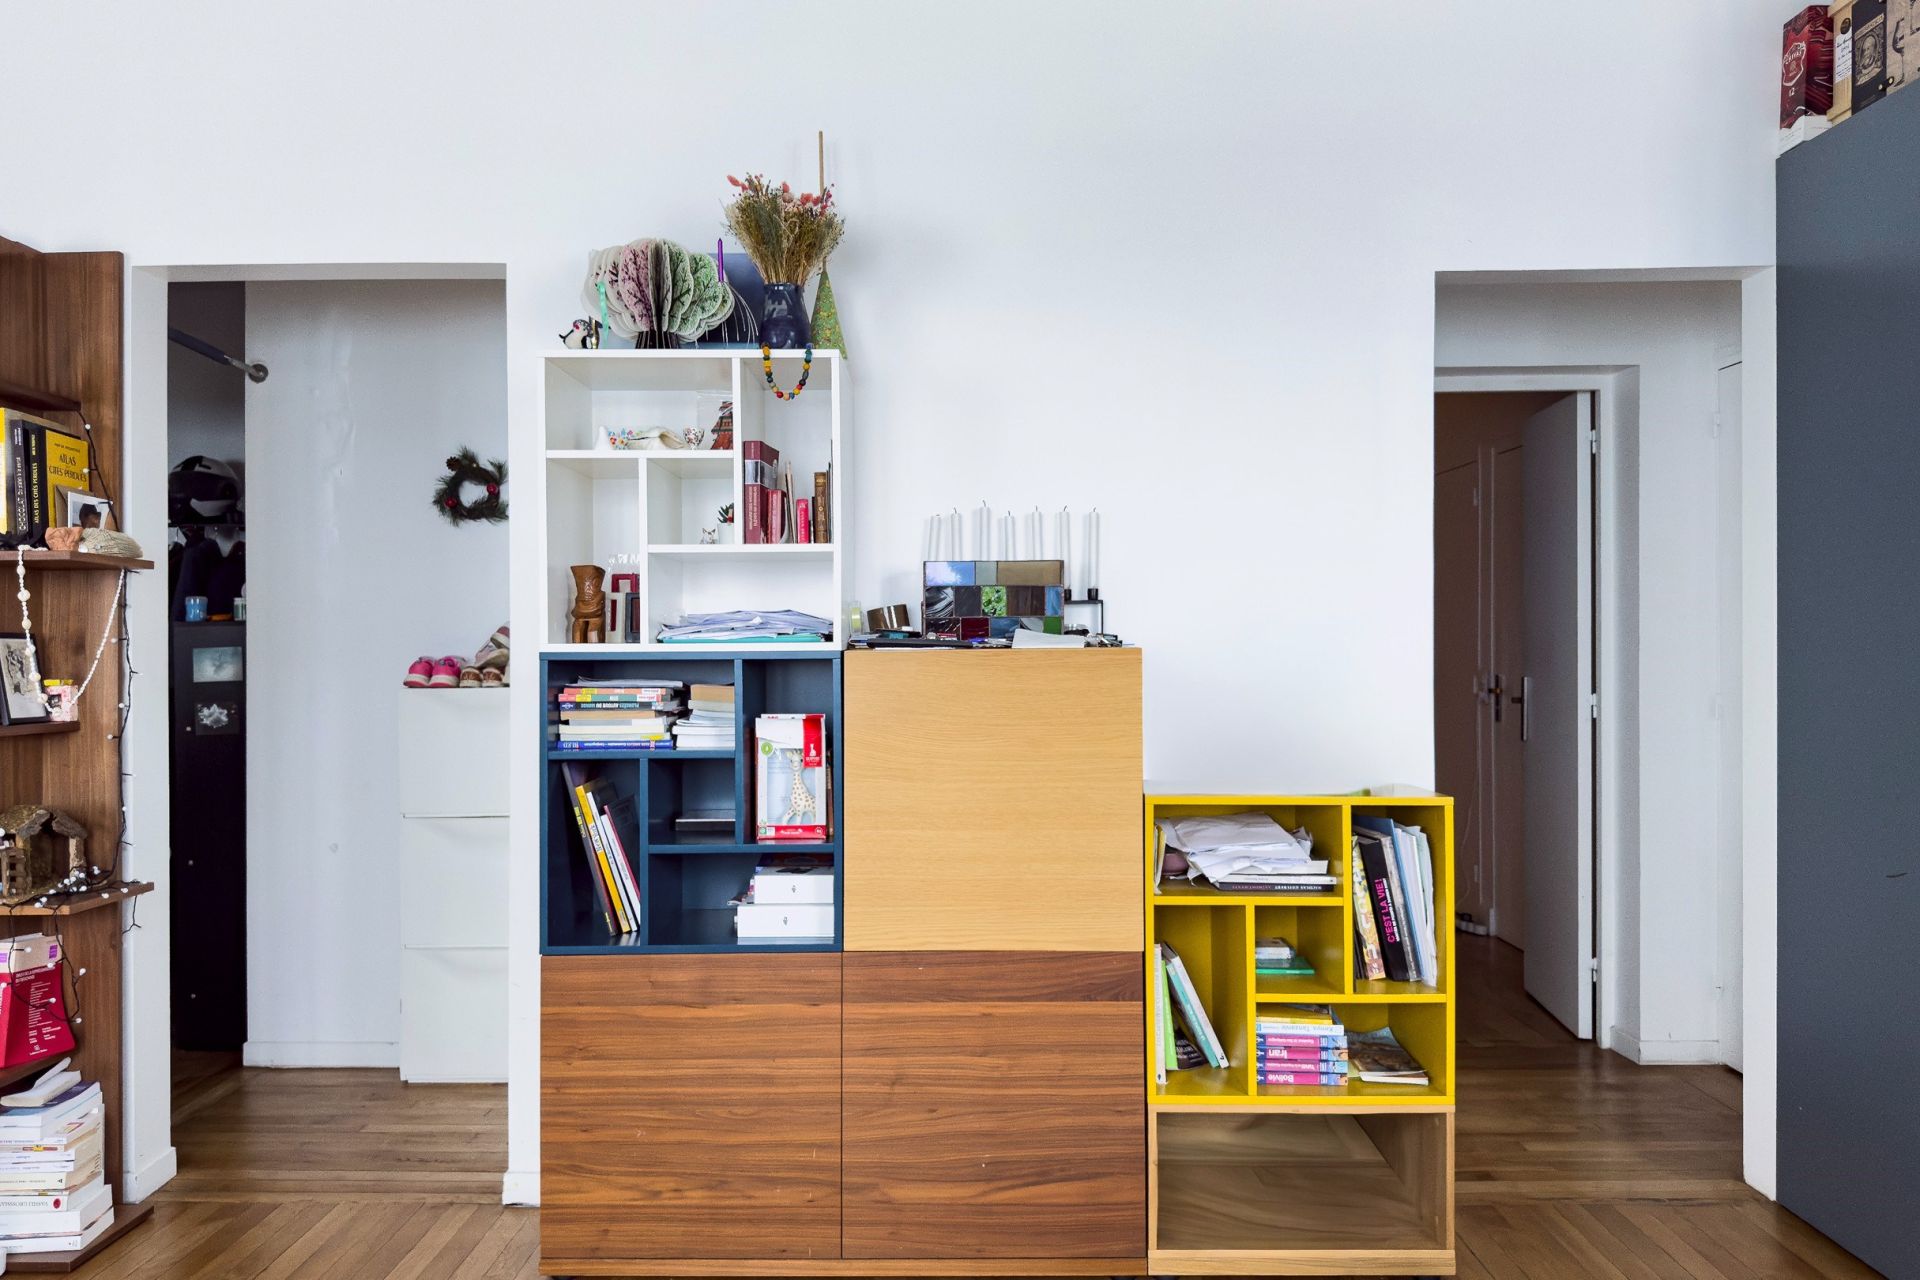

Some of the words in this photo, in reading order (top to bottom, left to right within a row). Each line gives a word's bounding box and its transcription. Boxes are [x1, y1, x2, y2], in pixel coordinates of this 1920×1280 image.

[60, 455, 76, 466] ATLAS
[17, 497, 26, 531] CHOCOLAT
[1380, 899, 1390, 912] LA
[1382, 914, 1395, 943] C'EST
[1268, 1049, 1287, 1059] Iran
[1267, 1074, 1294, 1083] Bolivie
